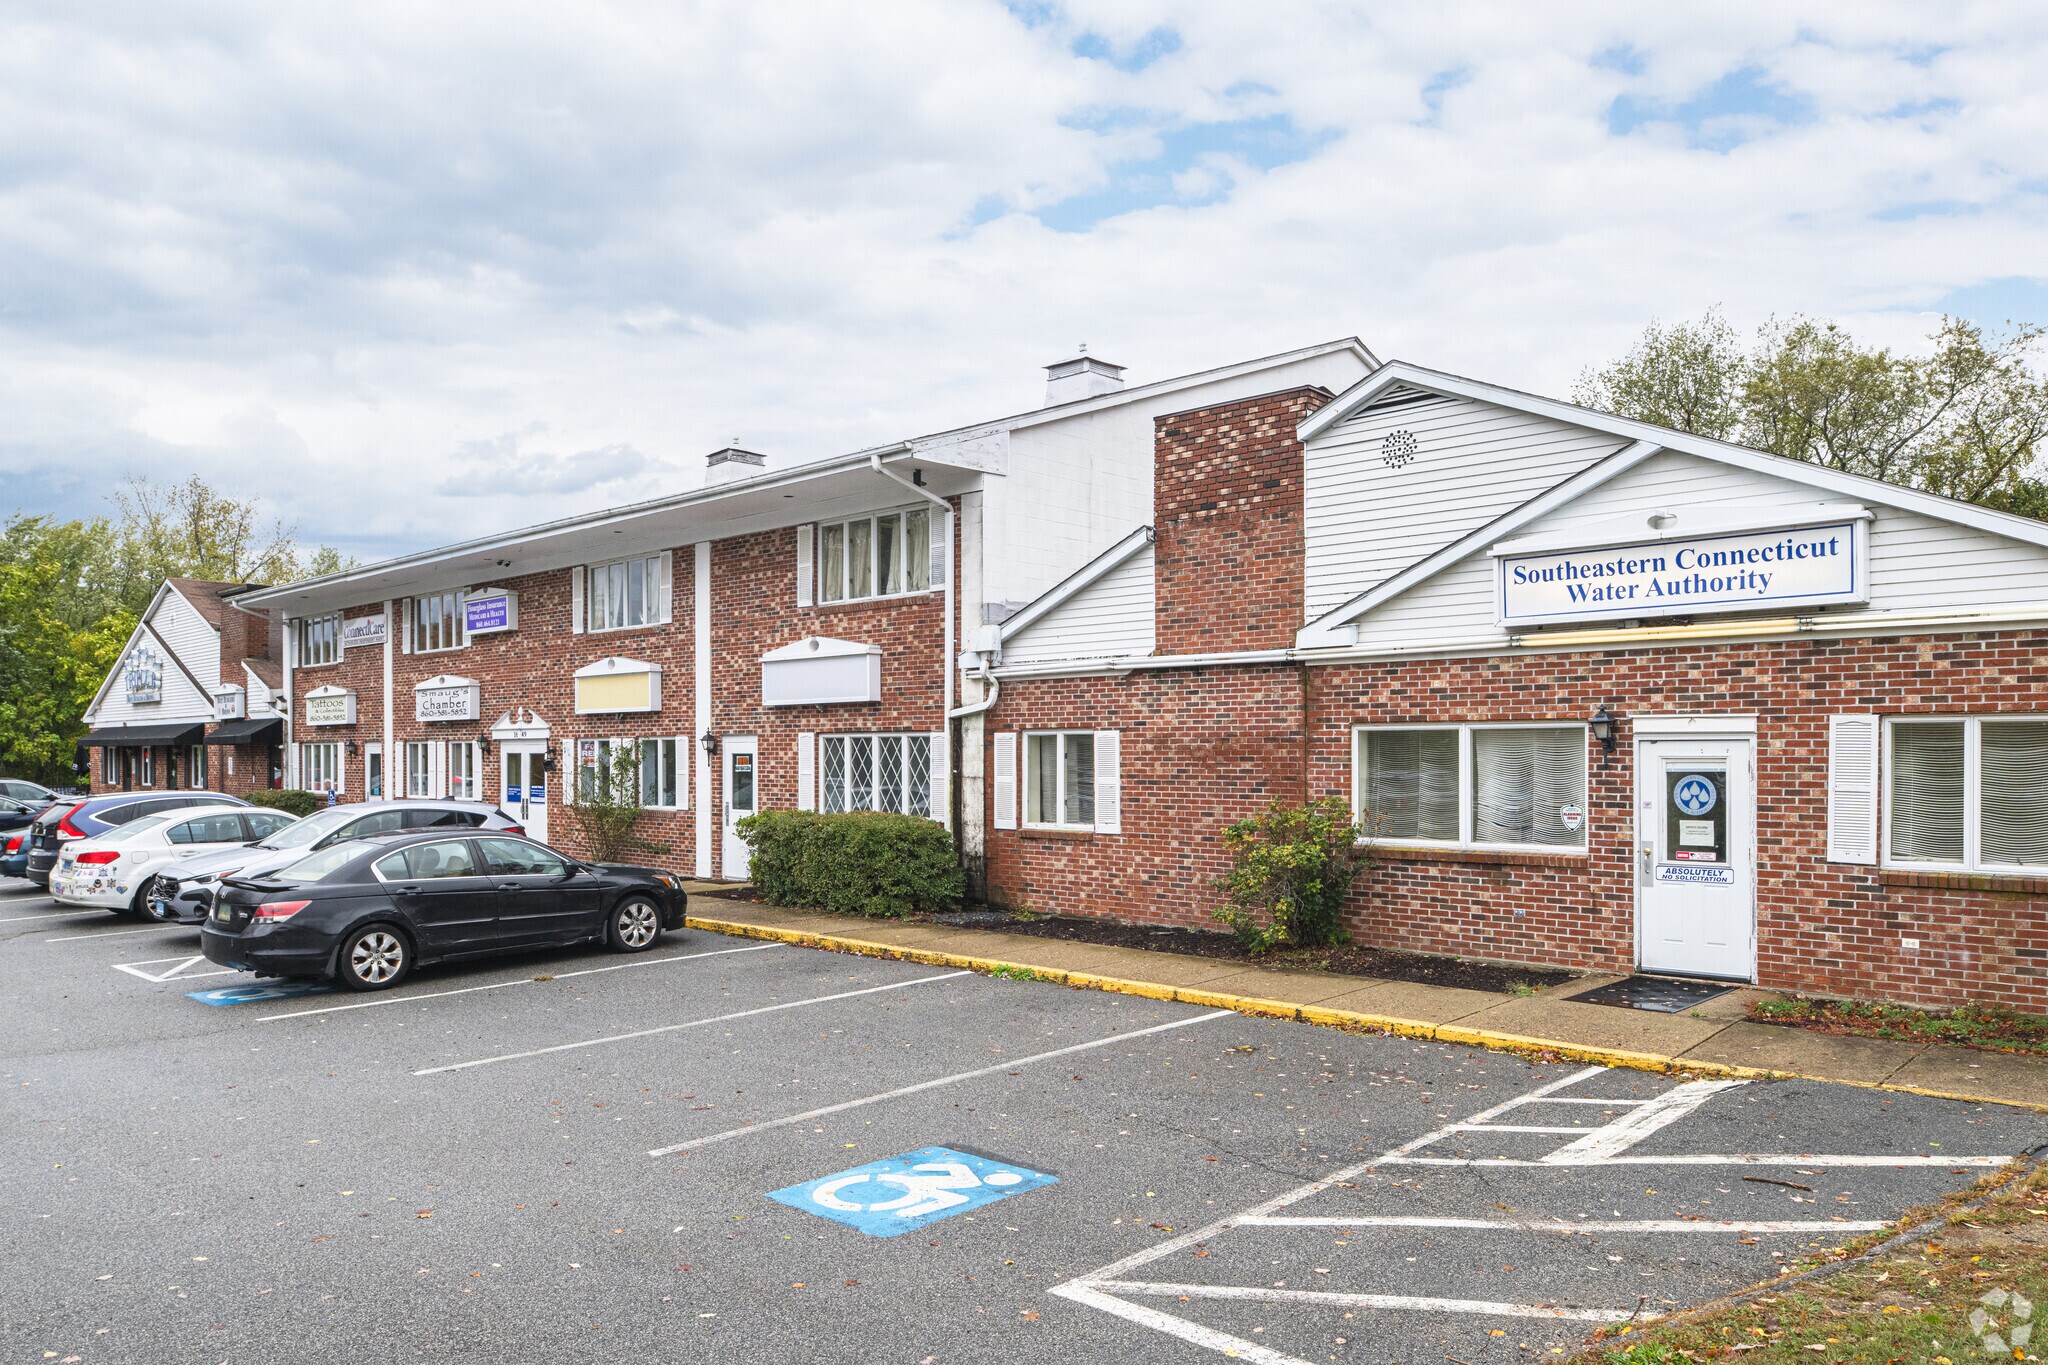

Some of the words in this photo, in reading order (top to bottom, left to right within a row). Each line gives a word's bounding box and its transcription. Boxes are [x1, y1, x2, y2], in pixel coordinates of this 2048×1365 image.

[1513, 556, 1666, 585] Southeastern
[1675, 536, 1839, 570] Connecticut
[1566, 583, 1640, 603] Water
[1646, 568, 1774, 595] Authority
[420, 688, 469, 698] Smaug's
[310, 699, 344, 708] Tattoos
[422, 696, 466, 710] Chamber
[1665, 867, 1724, 877] ABSOLUTELY
[1675, 875, 1728, 883] SOLICITATION
